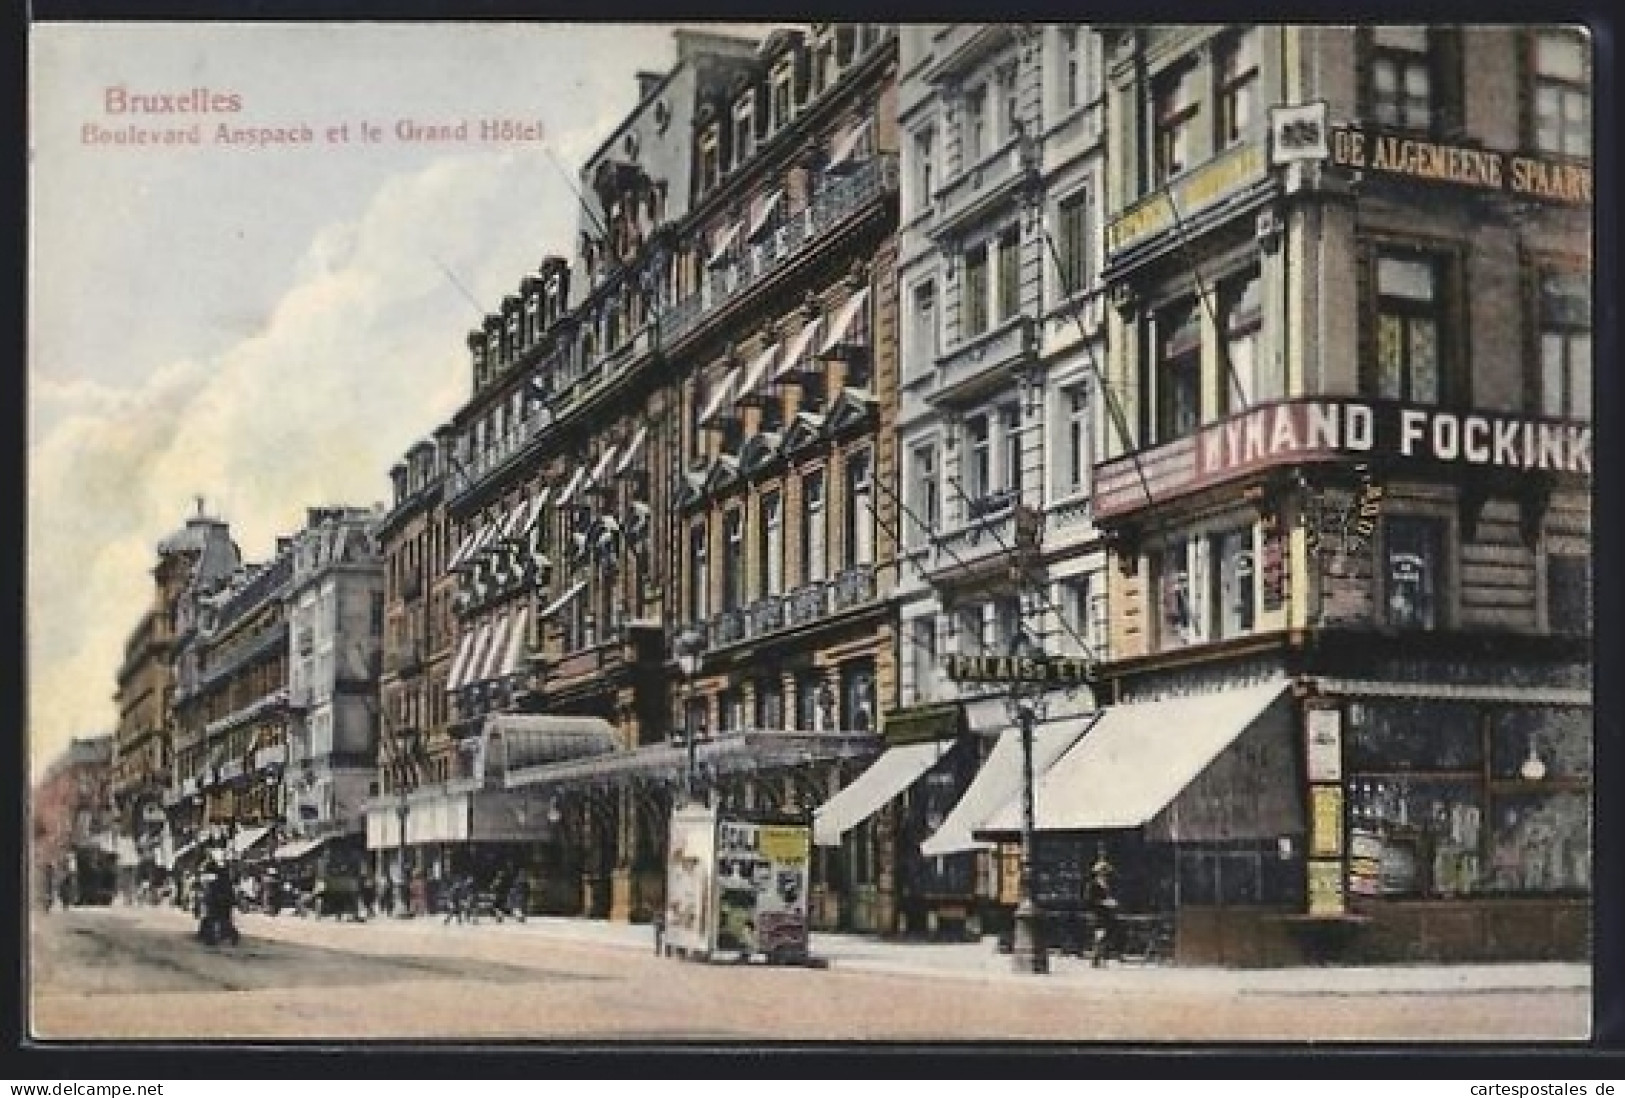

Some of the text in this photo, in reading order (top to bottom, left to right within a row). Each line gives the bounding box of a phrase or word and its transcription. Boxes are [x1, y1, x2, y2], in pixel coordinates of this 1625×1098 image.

[1333, 130, 1365, 167] DE
[1372, 136, 1502, 190] ALGEMEENE
[1400, 409, 1592, 474] FOCKINK
